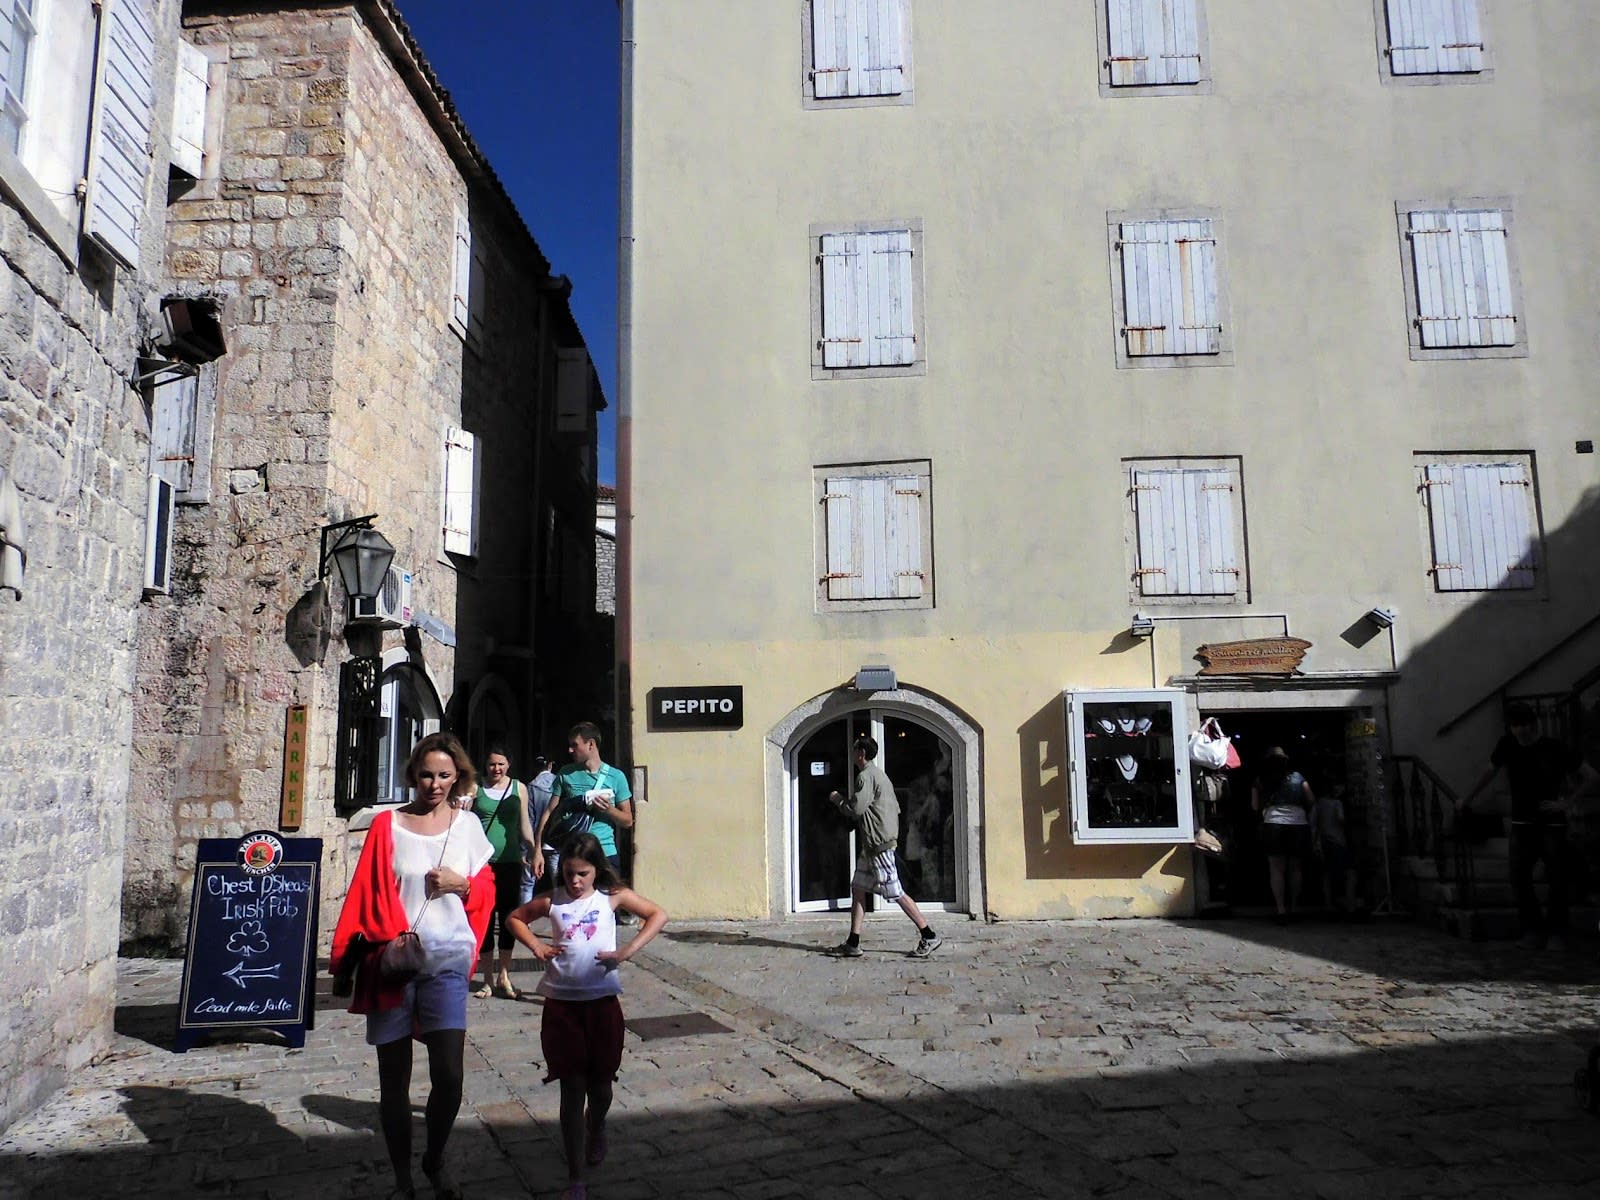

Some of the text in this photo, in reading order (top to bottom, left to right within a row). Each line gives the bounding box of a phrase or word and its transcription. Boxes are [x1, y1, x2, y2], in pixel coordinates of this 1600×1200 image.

[661, 698, 734, 714] PEPITO
[287, 711, 304, 823] MARKET
[239, 835, 281, 853] PAULANER
[207, 875, 257, 896] Chest
